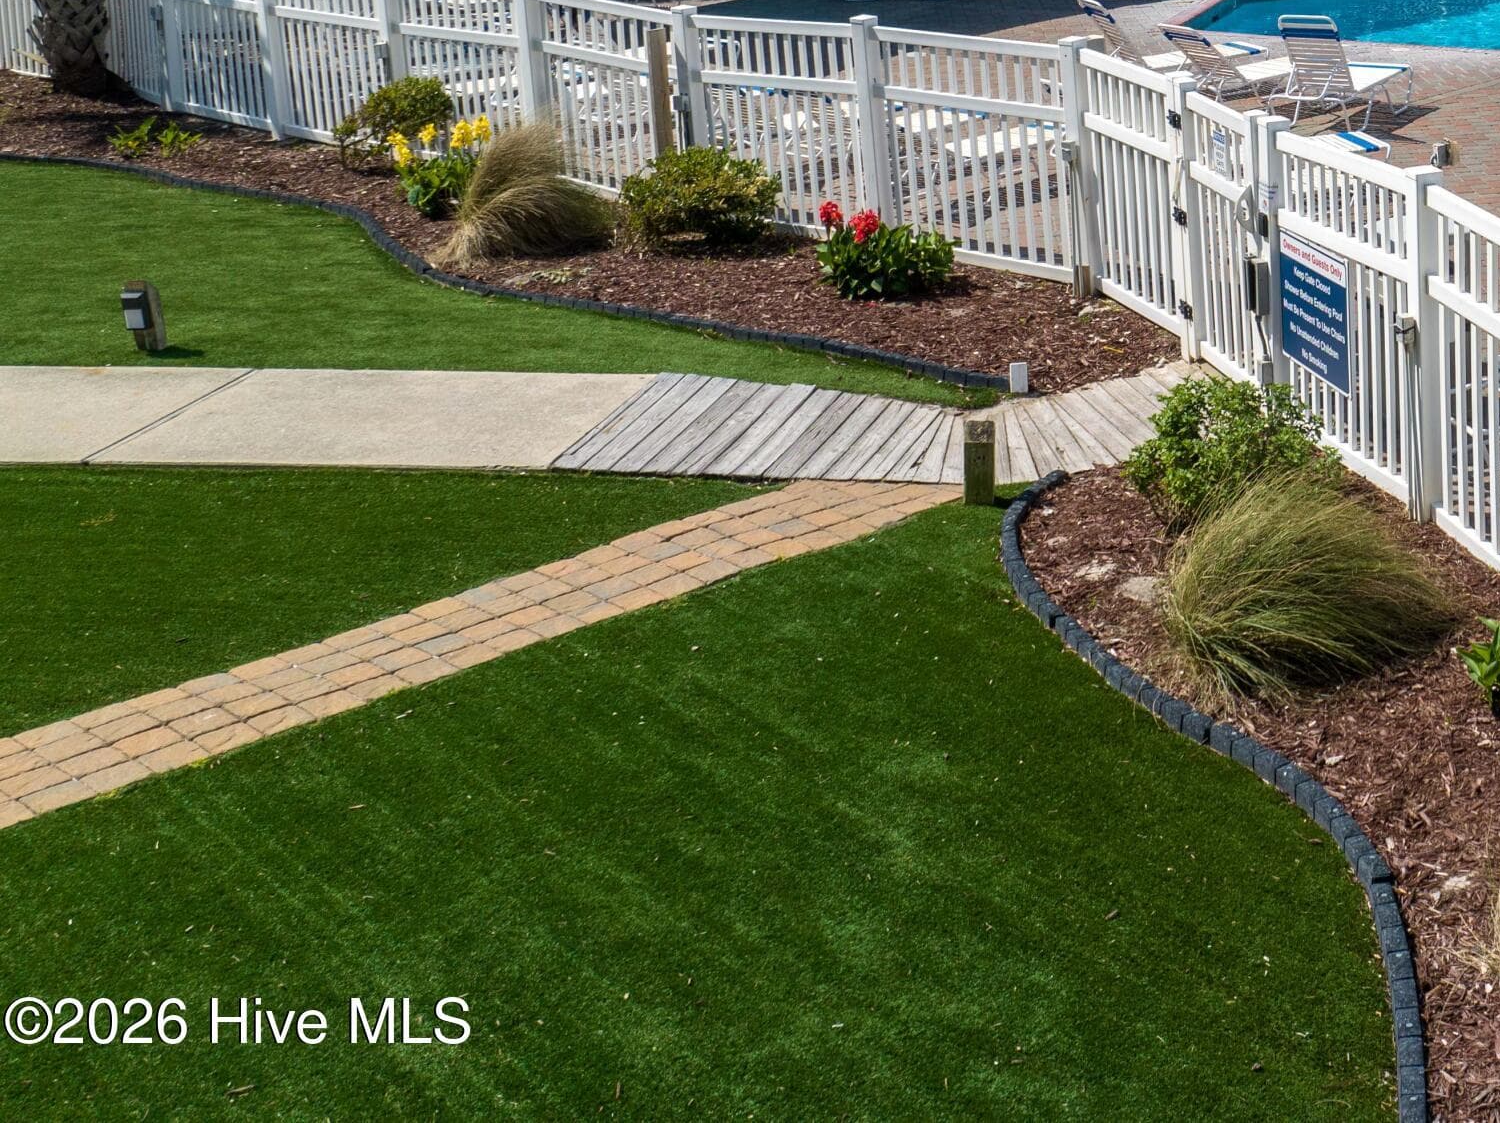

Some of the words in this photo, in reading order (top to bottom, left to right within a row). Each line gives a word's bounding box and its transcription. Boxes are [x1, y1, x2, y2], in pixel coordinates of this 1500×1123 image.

[1282, 238, 1301, 256] Owners
[1301, 251, 1311, 262] and
[1311, 254, 1329, 273] Guests
[1329, 264, 1343, 281] Only
[1293, 265, 1305, 282] Keep
[1304, 272, 1316, 286] Gate
[1315, 278, 1331, 296] Closed
[1283, 297, 1294, 312] Must
[1293, 304, 1300, 316] Be
[1299, 307, 1316, 326] Present
[1315, 317, 1322, 330] To
[1321, 321, 1331, 335] Use
[1330, 327, 1346, 345] Chairs
[1284, 279, 1300, 296] Shower
[1299, 288, 1314, 305] Before
[1313, 297, 1332, 319] Entering
[1332, 307, 1343, 323] Pool
[1289, 320, 1297, 333] No
[1296, 324, 1321, 349] Unattended
[1320, 340, 1340, 361] Children
[1301, 347, 1309, 360] No
[1308, 352, 1328, 375] Smoking
